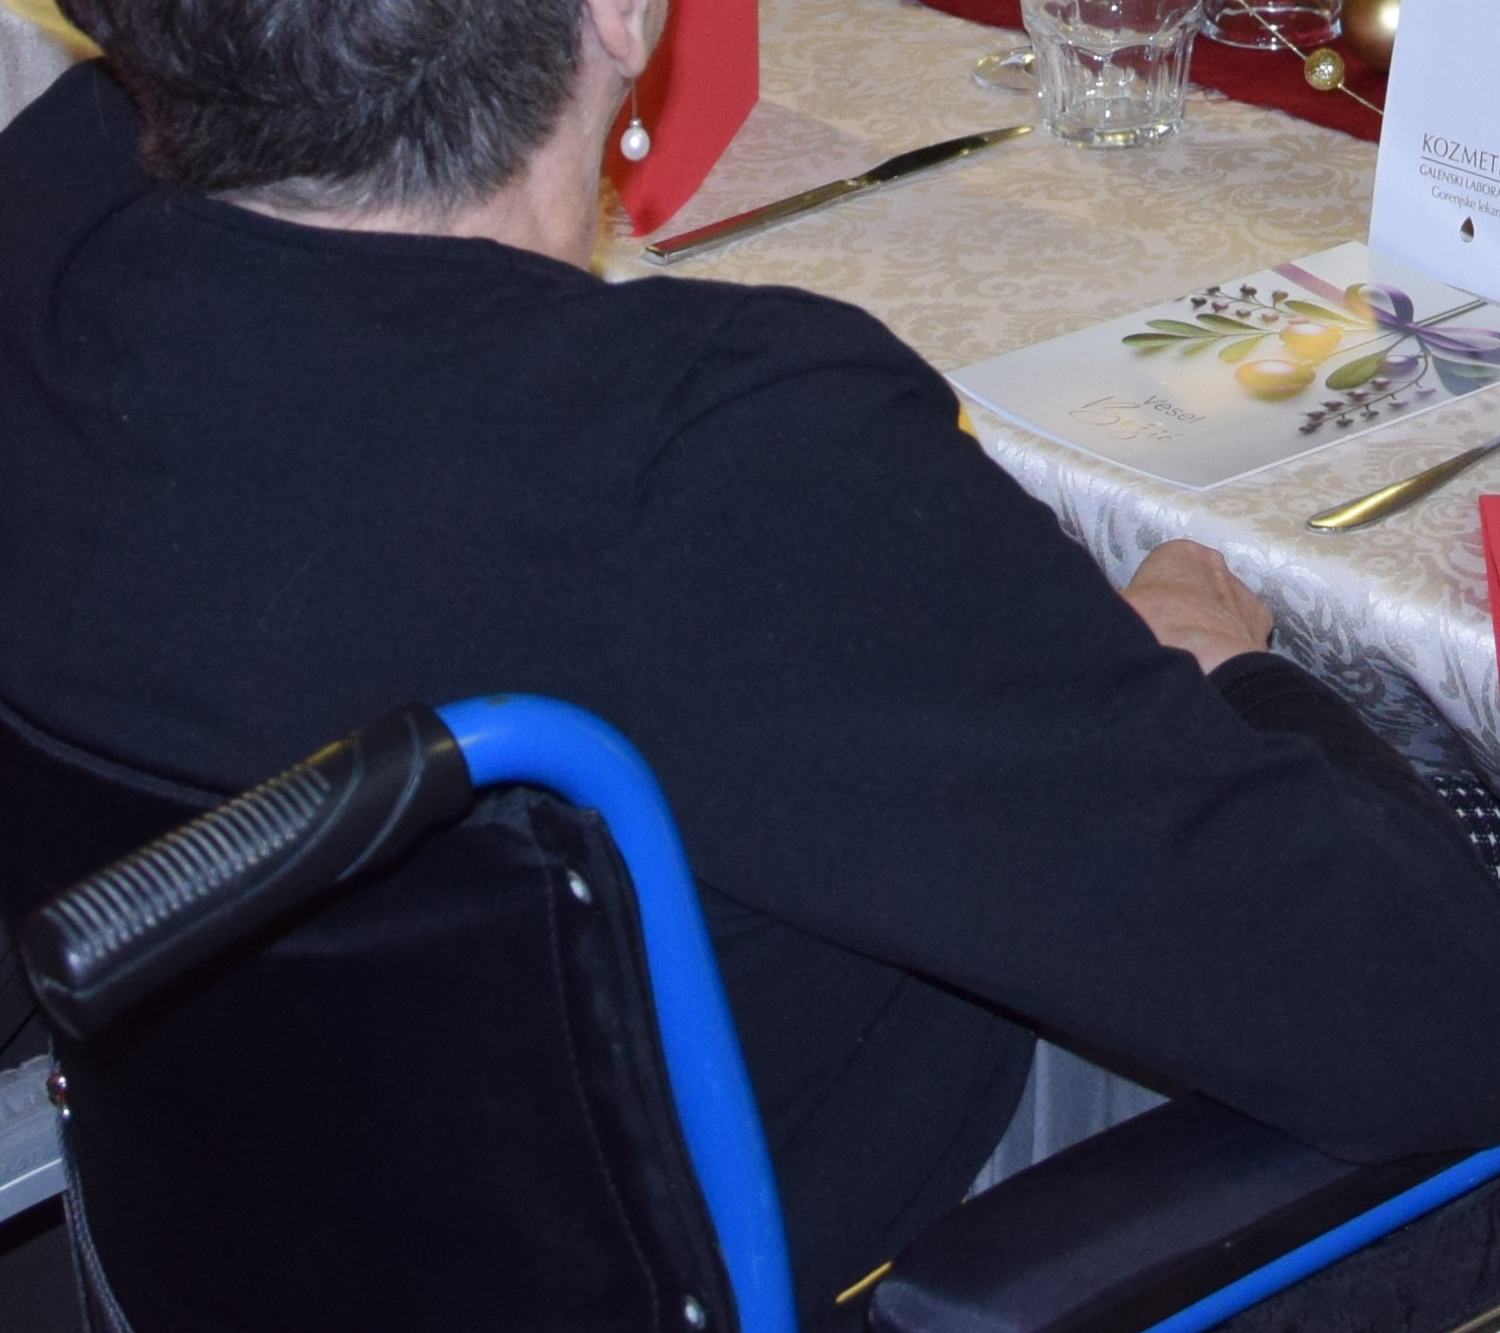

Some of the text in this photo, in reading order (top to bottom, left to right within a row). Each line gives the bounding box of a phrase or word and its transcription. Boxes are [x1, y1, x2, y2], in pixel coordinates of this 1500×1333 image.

[1420, 164, 1463, 187] GALENSKI
[1431, 185, 1477, 210] Gorenjske
[1143, 394, 1207, 424] Vesel
